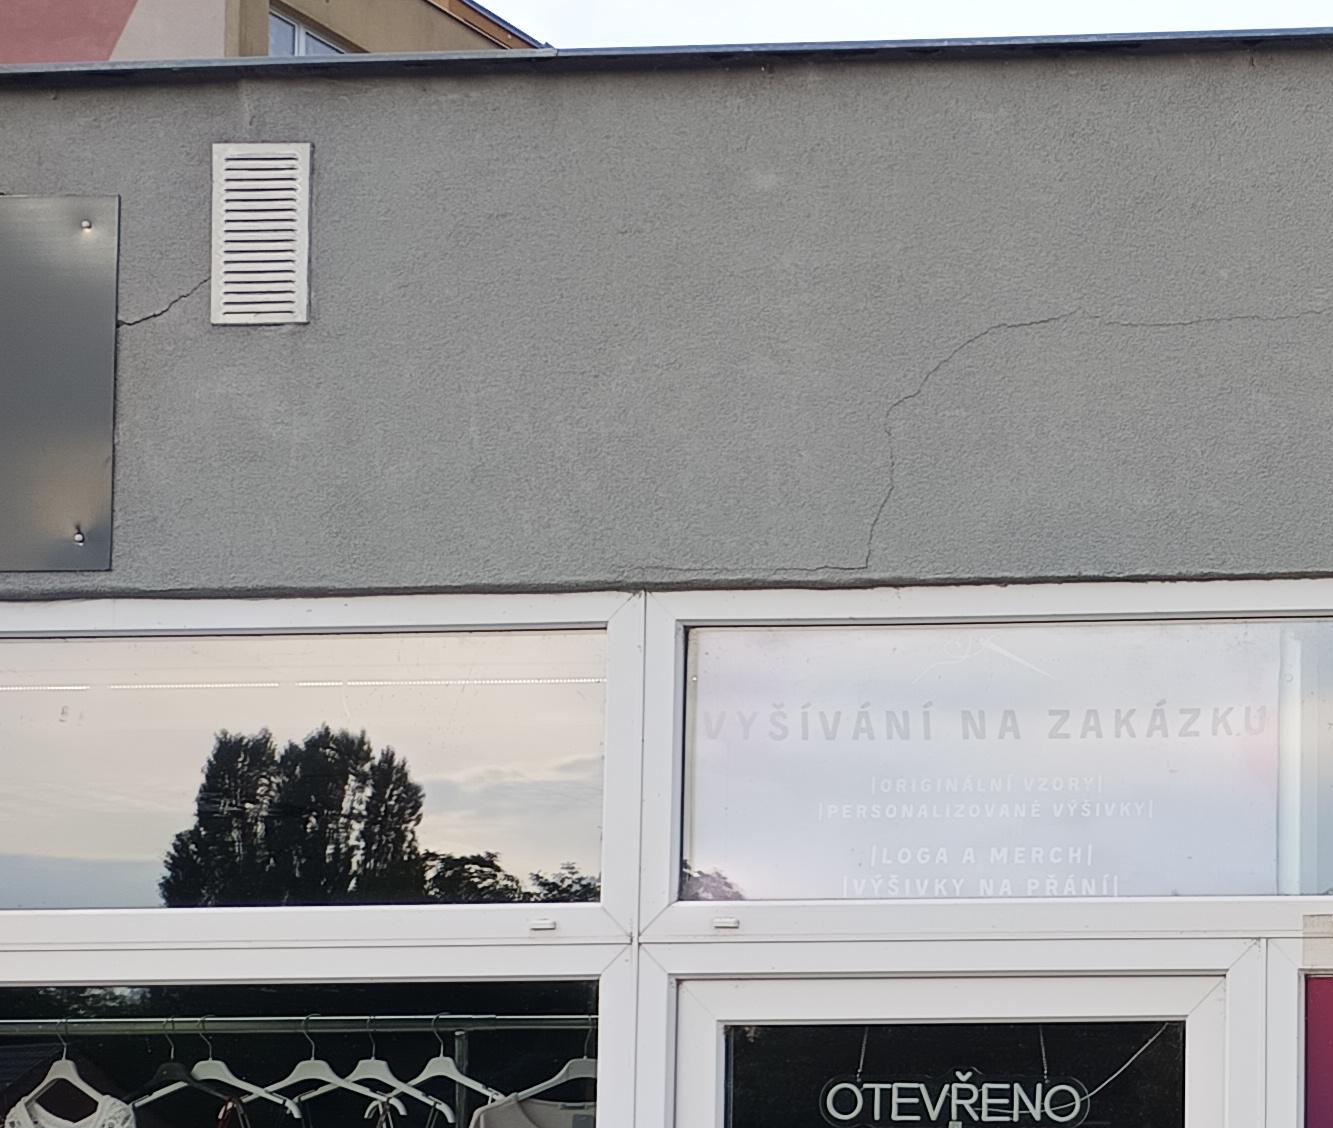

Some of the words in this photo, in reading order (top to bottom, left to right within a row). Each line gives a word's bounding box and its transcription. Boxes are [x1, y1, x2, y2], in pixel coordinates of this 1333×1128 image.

[702, 700, 934, 741] VYŠÍVÁNÍ
[960, 708, 1022, 741] NA
[1048, 699, 1268, 741] ZAKÁZKU
[962, 847, 977, 864] A
[980, 878, 1014, 897] NA
[826, 1069, 1081, 1123] OTEVŘENO
